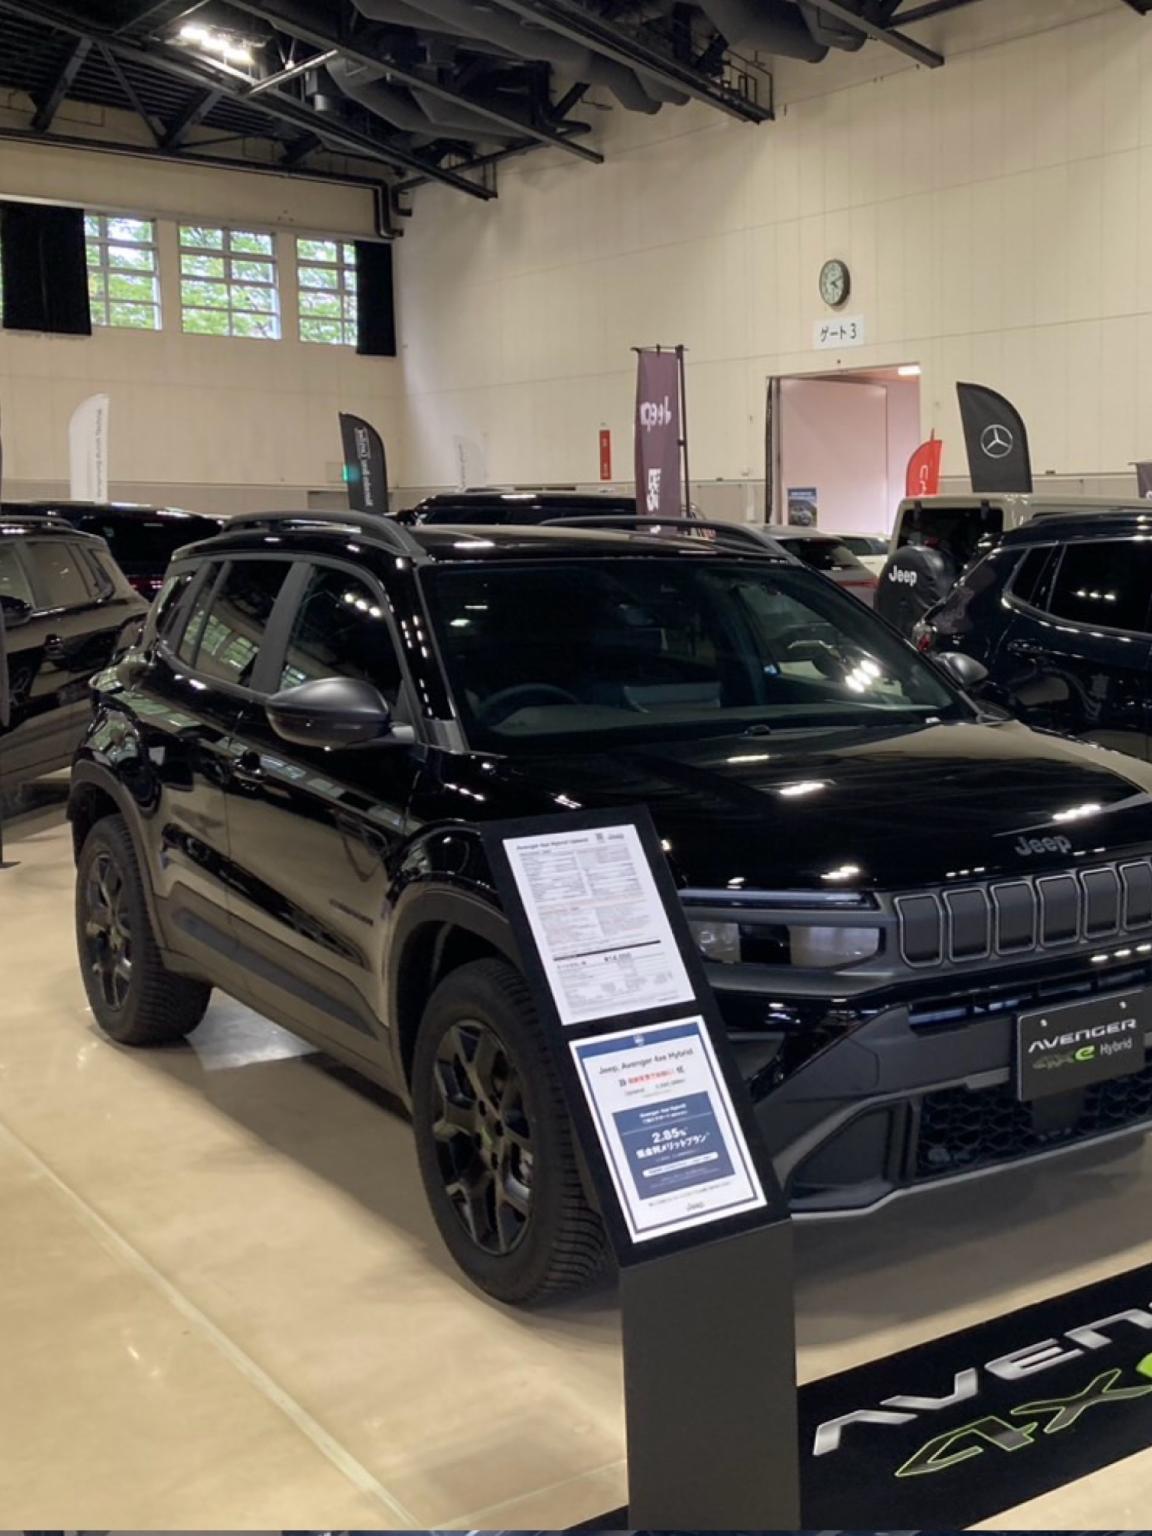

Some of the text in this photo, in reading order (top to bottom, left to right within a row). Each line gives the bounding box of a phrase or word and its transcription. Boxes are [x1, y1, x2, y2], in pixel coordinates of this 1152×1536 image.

[889, 565, 918, 587] Jeep
[1015, 835, 1072, 855] Jeep
[1028, 1018, 1137, 1053] AVENGER
[1100, 1038, 1133, 1056] Hybrid
